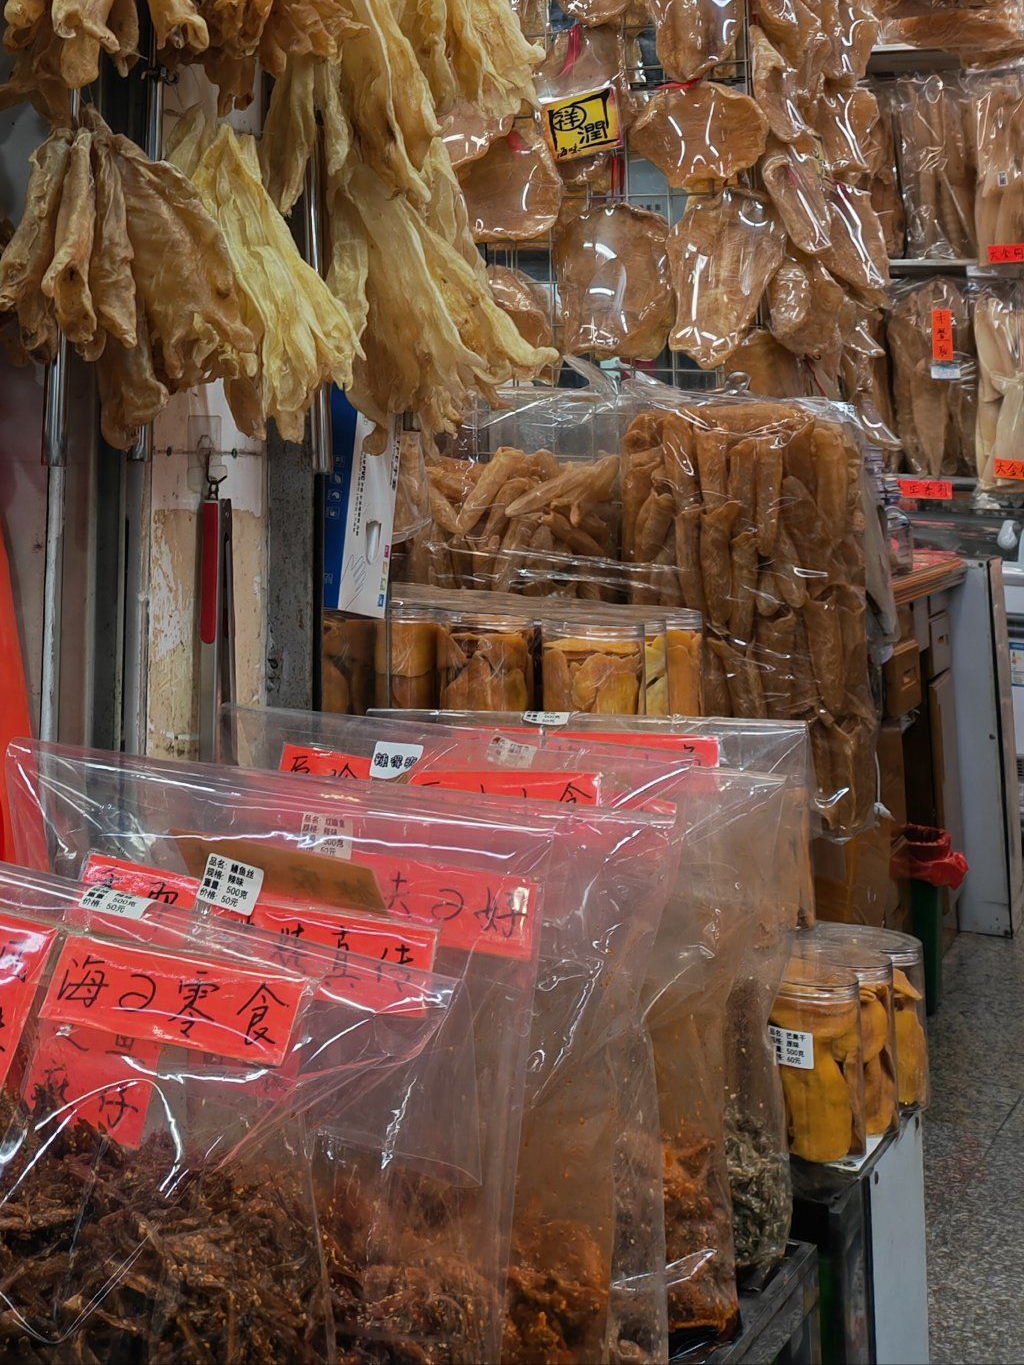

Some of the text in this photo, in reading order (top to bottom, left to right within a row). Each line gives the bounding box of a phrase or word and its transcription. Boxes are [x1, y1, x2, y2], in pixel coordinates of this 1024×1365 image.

[226, 885, 248, 899] 500克
[220, 895, 238, 907] 50元
[106, 902, 126, 913] 50元
